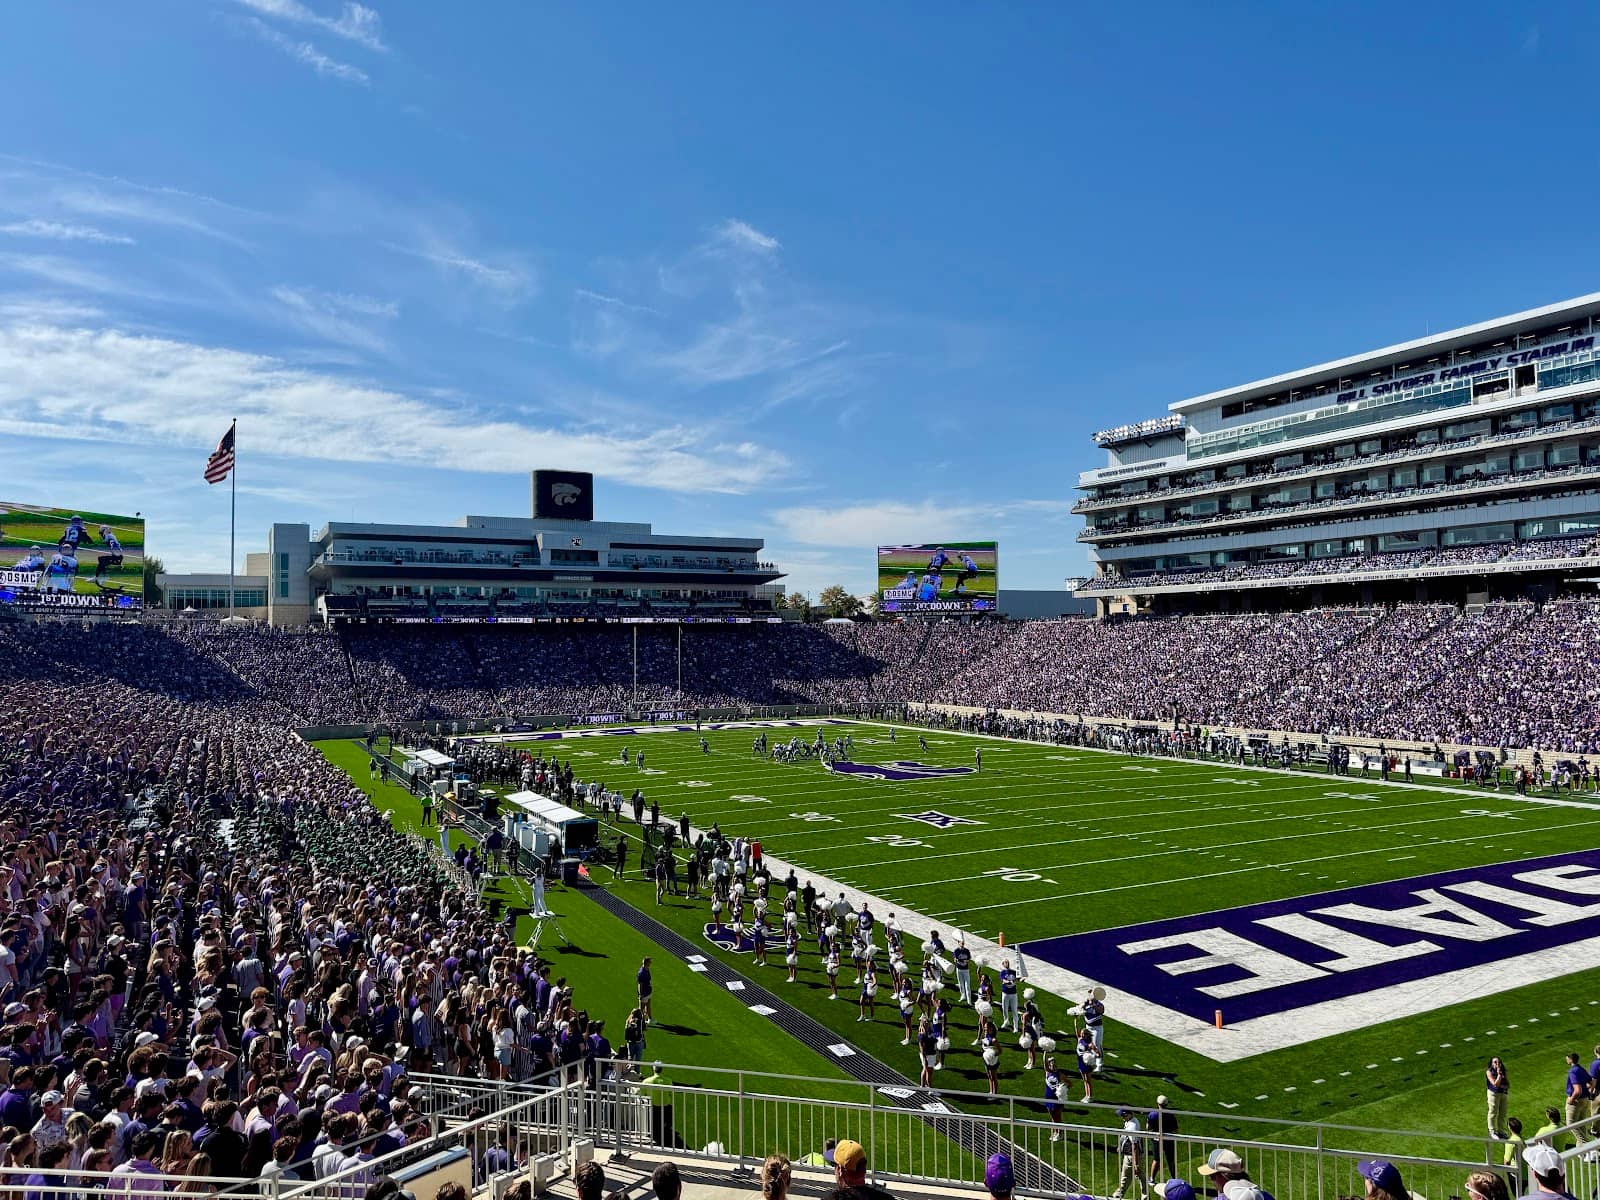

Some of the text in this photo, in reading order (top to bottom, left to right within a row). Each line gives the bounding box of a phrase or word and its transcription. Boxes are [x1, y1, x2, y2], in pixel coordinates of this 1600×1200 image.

[1336, 336, 1595, 404] BILL SNYDER FAMILY STADIUM
[60, 594, 100, 606] DOWN
[930, 602, 961, 610] DOWN
[864, 834, 923, 847] 20
[982, 867, 1042, 882] 10
